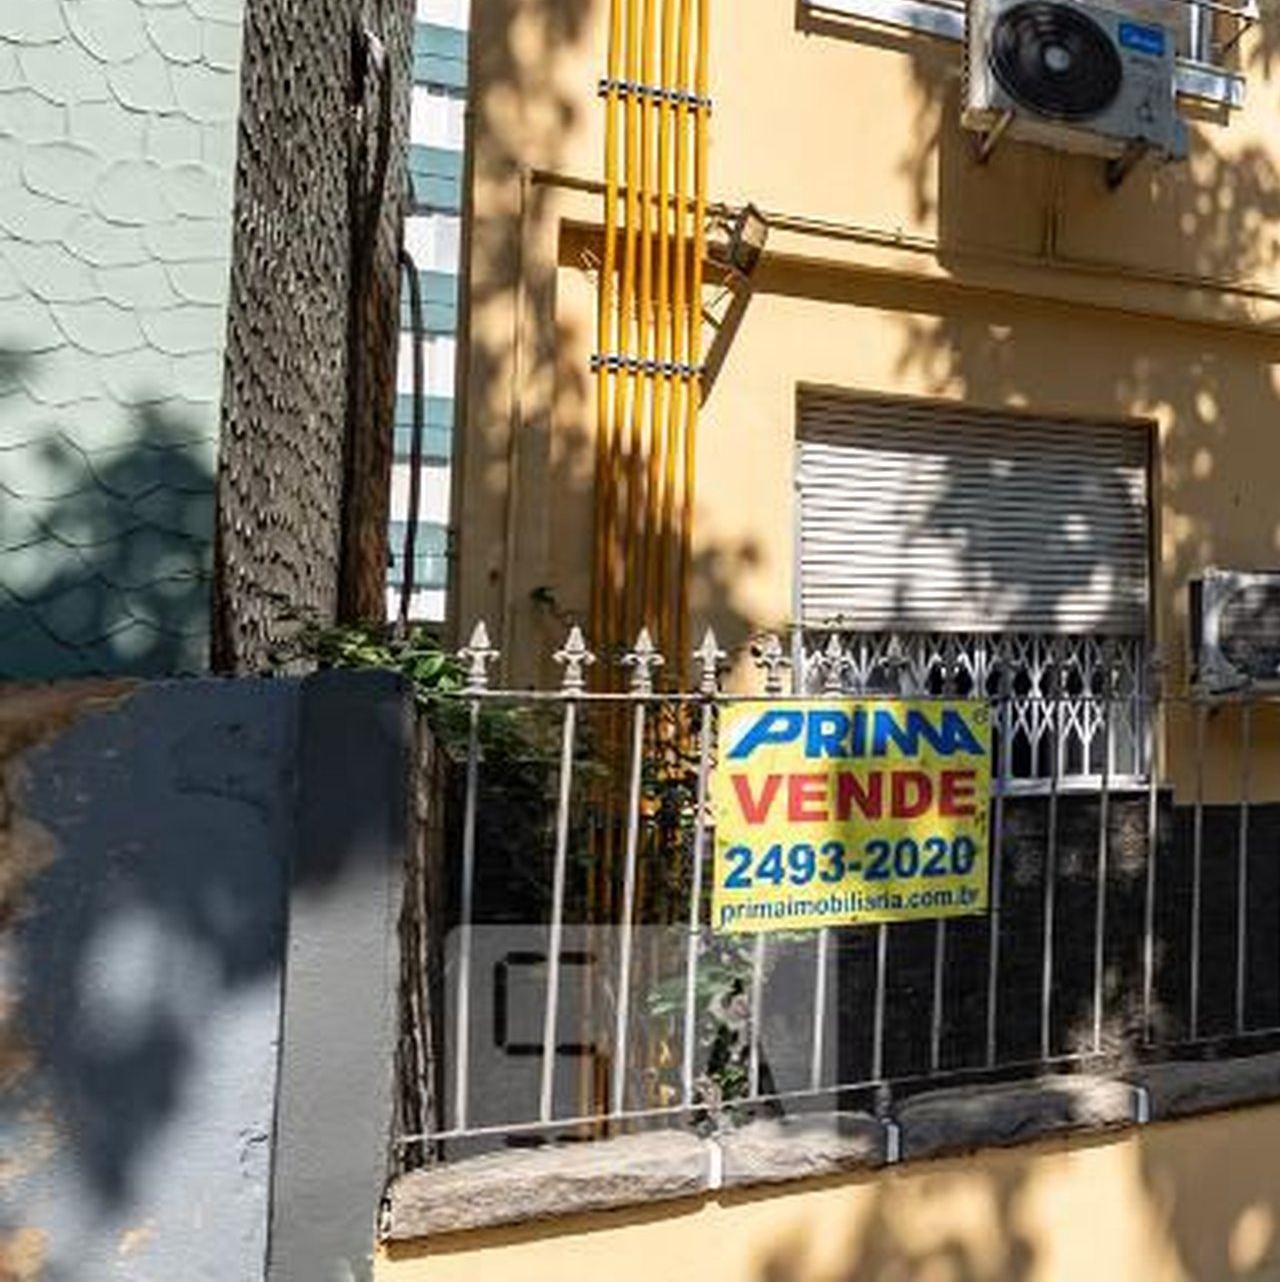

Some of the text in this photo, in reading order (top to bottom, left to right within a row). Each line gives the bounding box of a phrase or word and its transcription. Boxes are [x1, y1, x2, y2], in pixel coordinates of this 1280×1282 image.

[726, 709, 985, 759] PRIMA
[730, 771, 976, 826] VENDE
[723, 836, 977, 889] 2493-2020
